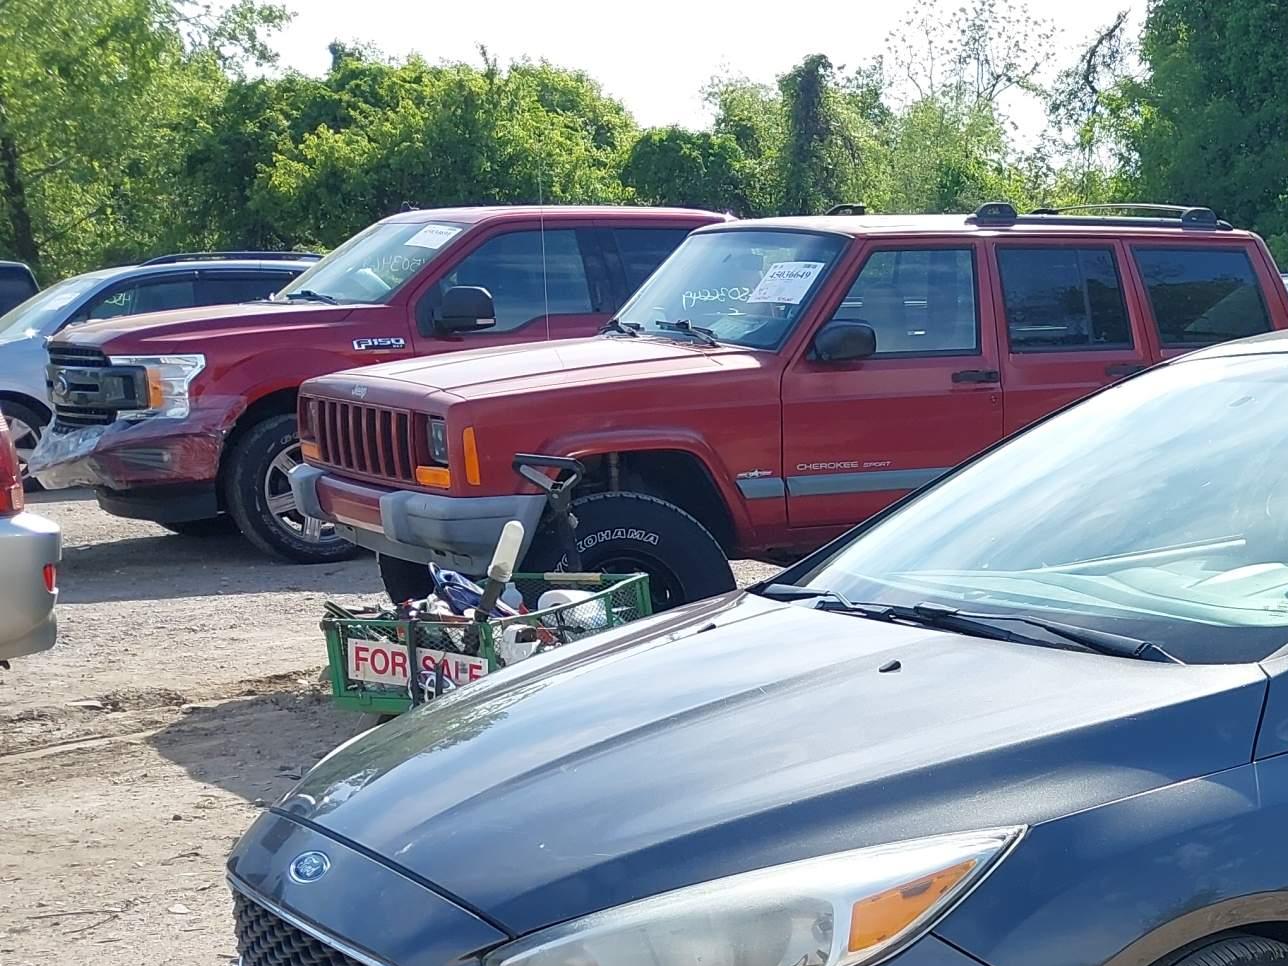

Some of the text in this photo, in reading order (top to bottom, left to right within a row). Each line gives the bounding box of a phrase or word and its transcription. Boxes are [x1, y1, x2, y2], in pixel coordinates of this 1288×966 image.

[796, 460, 892, 471] CHEROKEE SPORT
[354, 646, 408, 678] FOR
